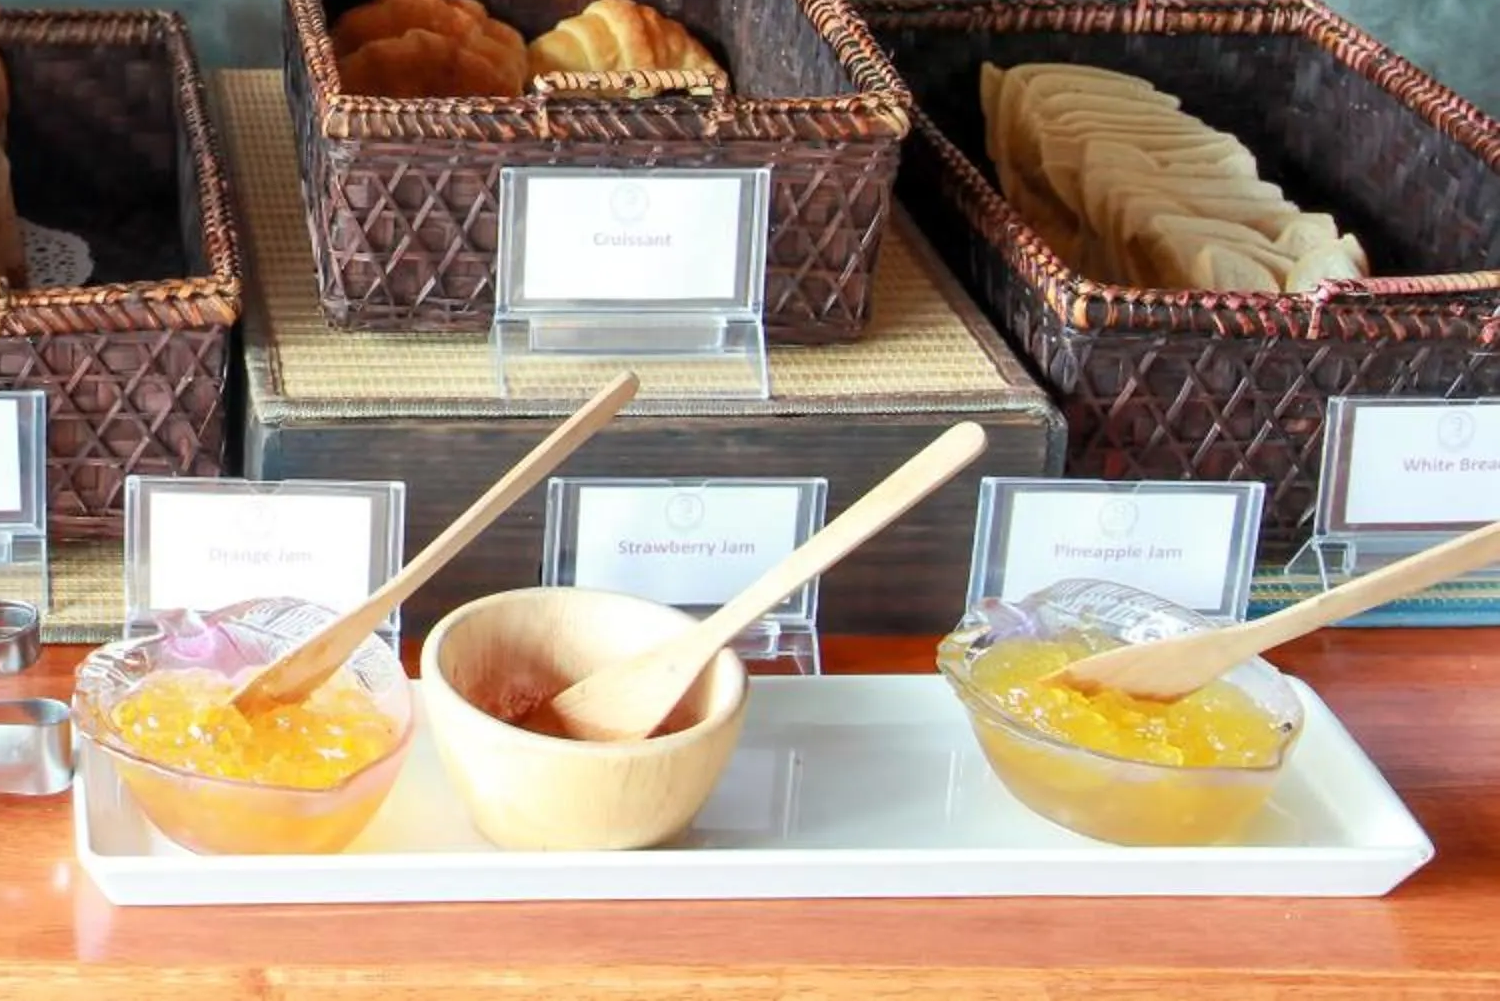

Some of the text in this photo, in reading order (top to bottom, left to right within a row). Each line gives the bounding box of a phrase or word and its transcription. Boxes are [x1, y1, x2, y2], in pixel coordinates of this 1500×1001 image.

[1402, 455, 1500, 472] White Brea
[278, 546, 313, 563] Jam
[618, 539, 756, 556] Strawberry Jam
[1054, 542, 1183, 563] Pineapple Jam
